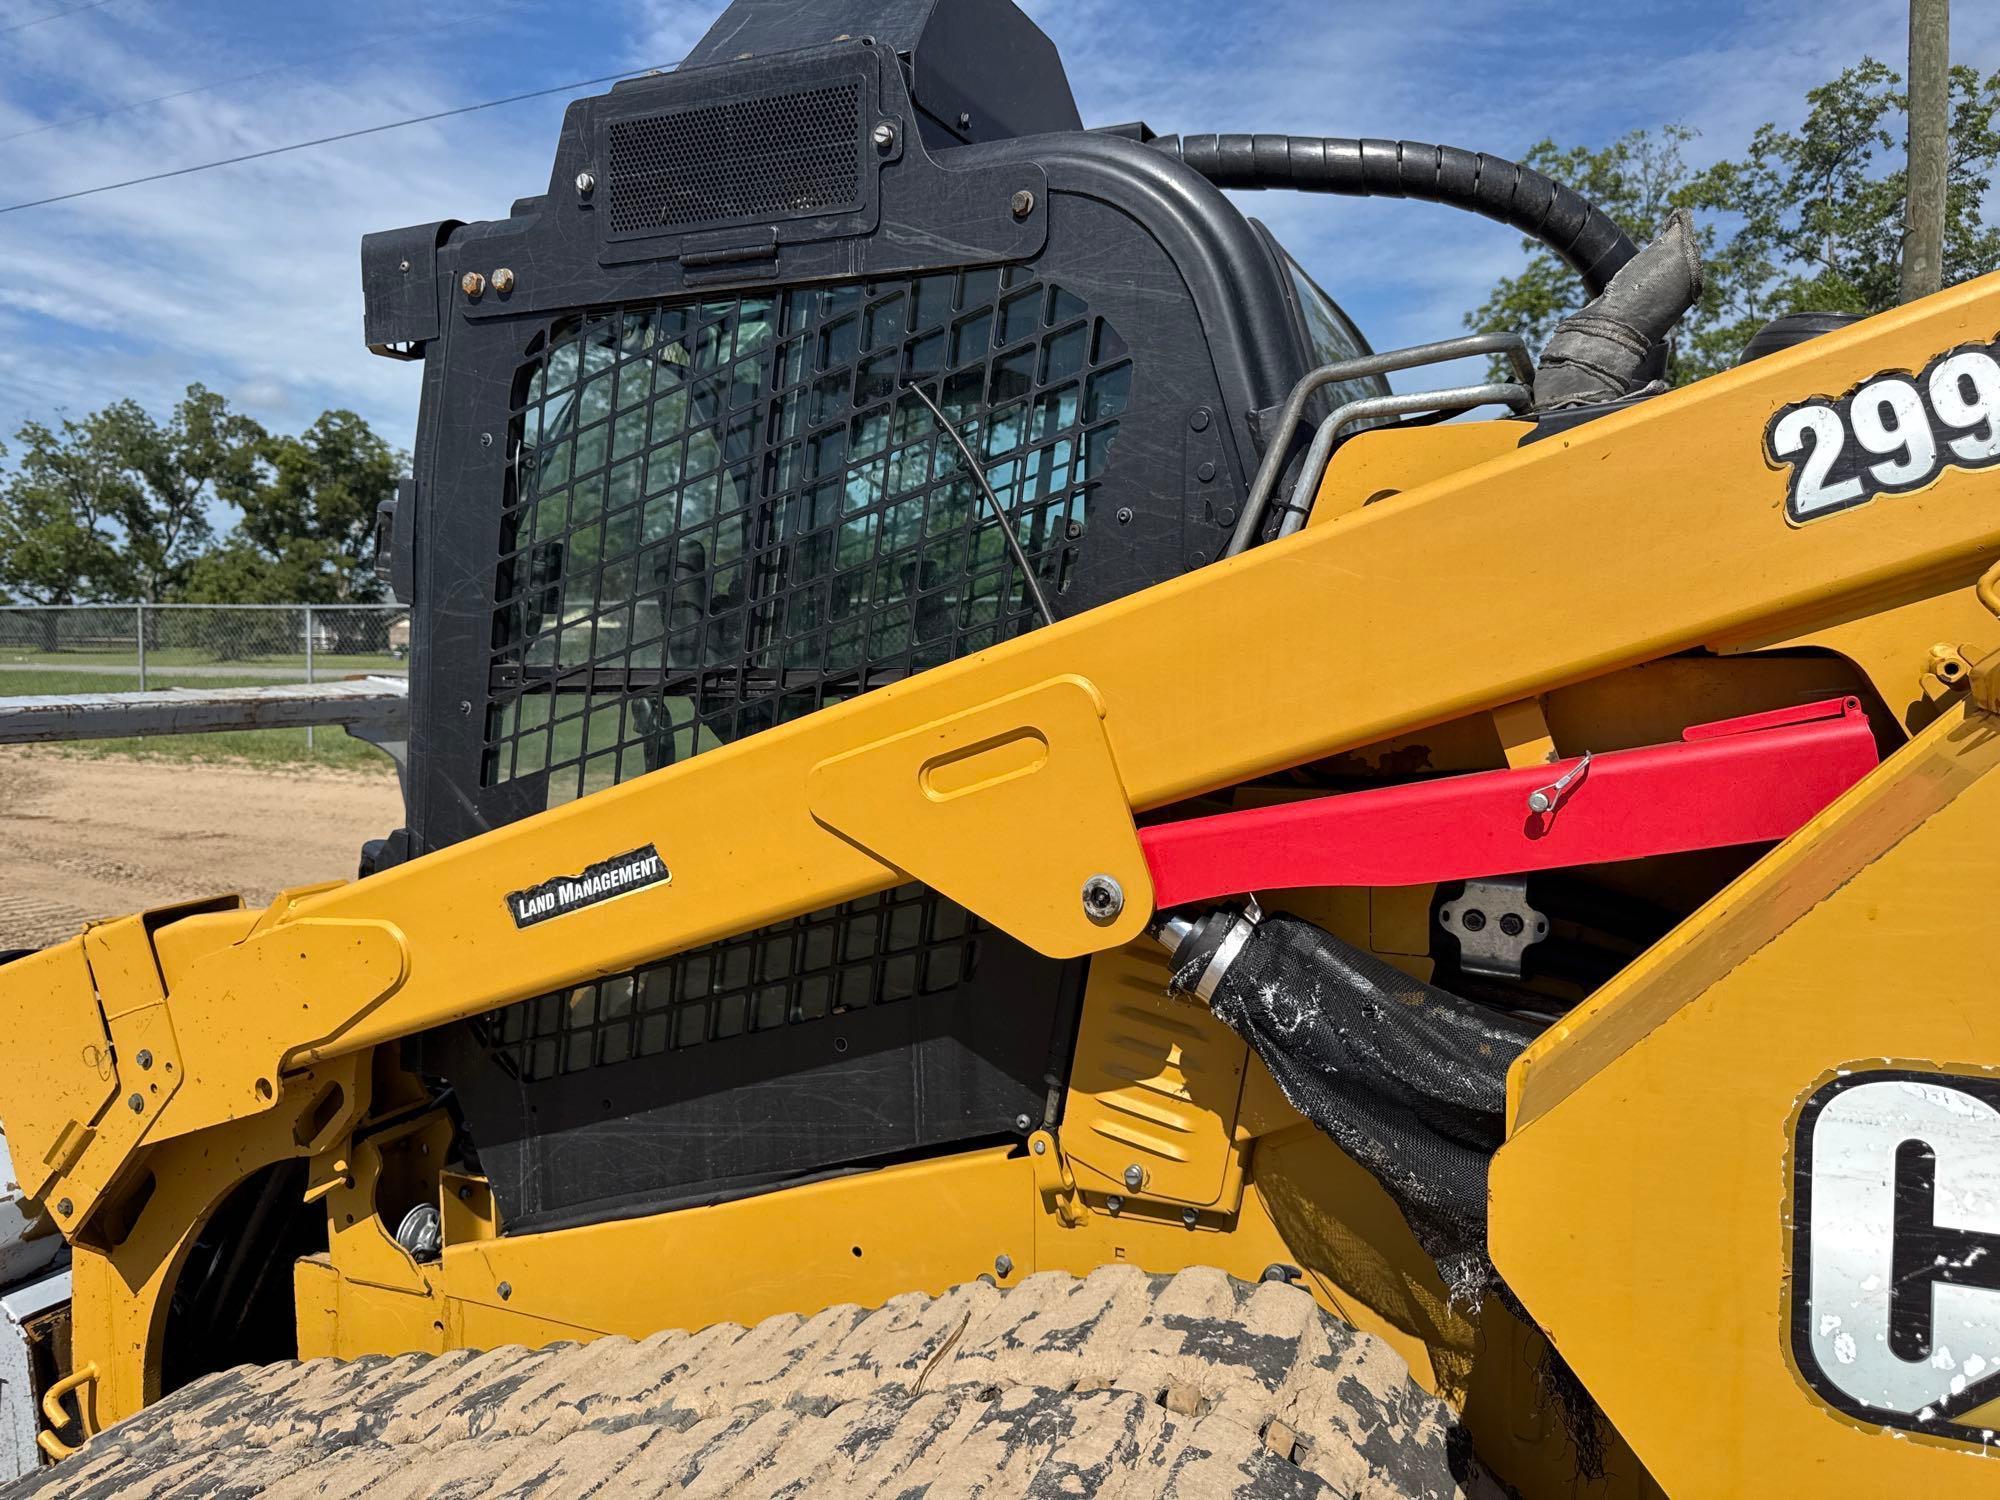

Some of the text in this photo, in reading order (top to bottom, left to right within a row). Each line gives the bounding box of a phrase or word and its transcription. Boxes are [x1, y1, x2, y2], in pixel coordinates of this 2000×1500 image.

[1774, 352, 2000, 514] 299
[519, 855, 658, 919] LAND MANAGEMENT
